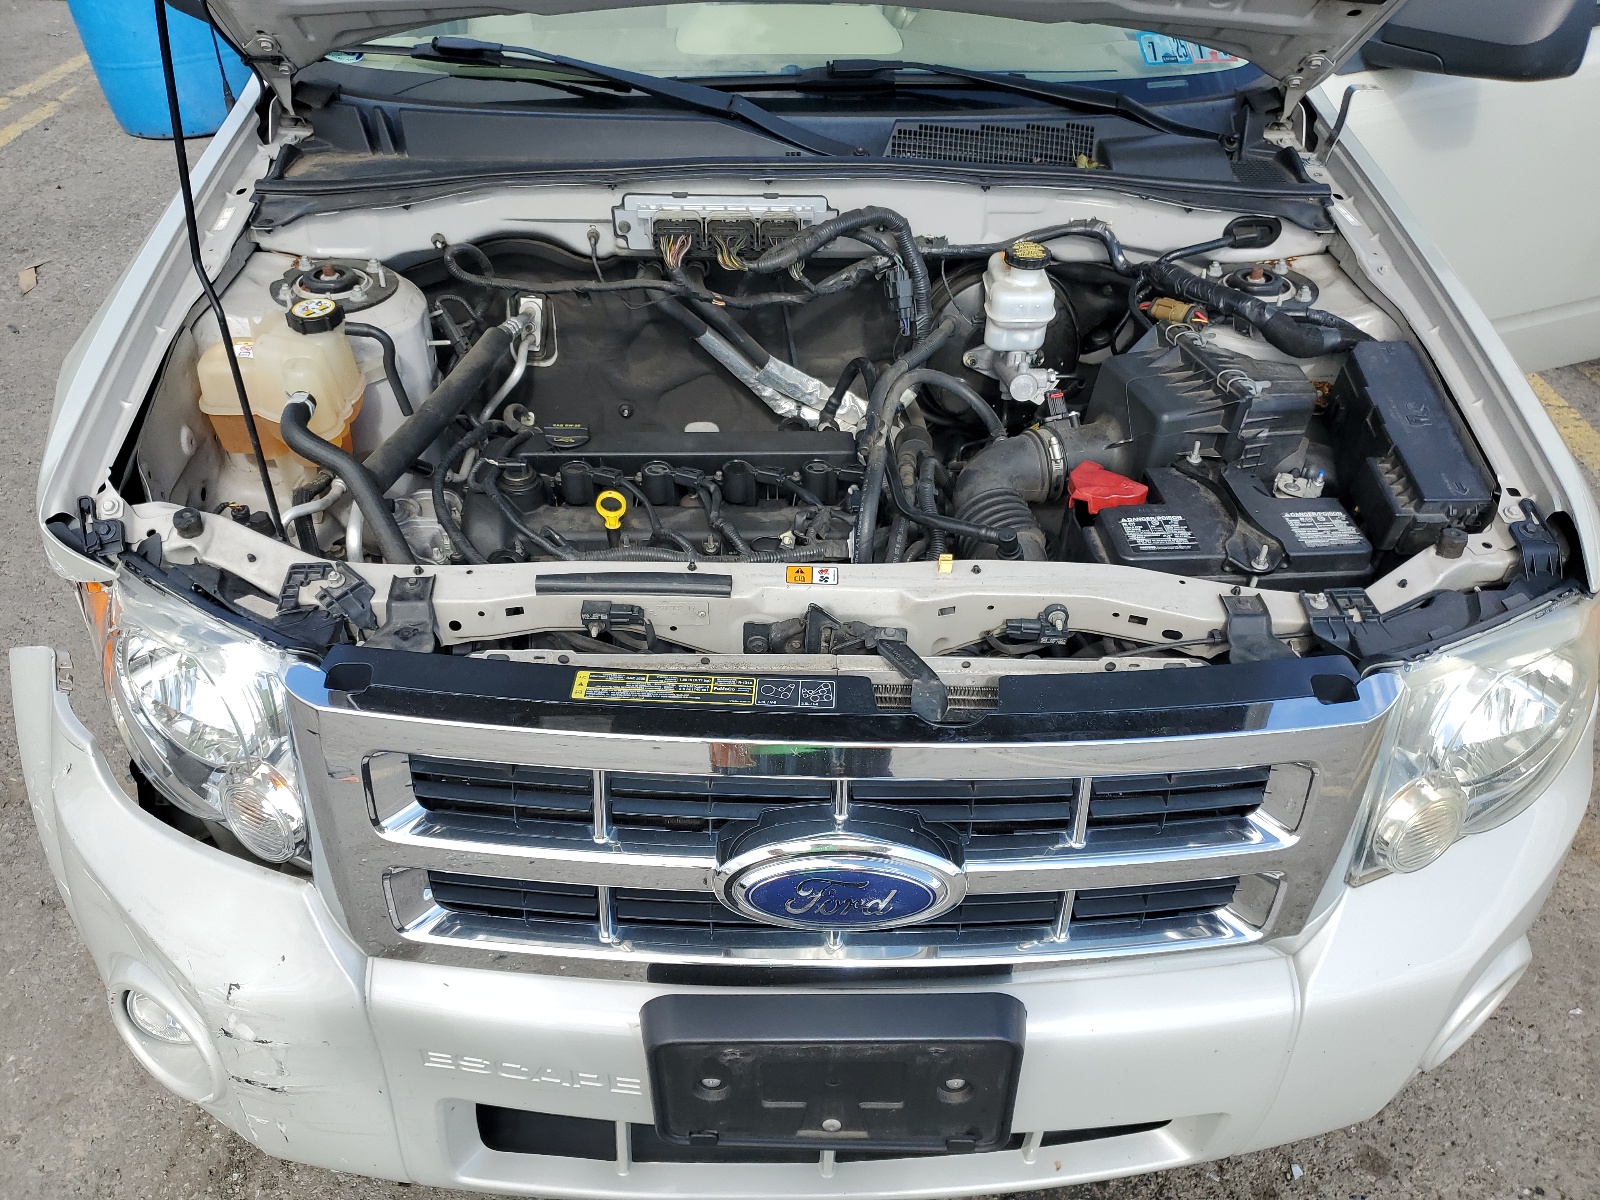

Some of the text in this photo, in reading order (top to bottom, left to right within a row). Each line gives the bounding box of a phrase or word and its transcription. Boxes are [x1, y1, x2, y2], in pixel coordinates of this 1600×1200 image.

[1147, 41, 1158, 62] 7
[784, 877, 898, 916] Ford
[419, 1049, 643, 1096] ESCAPE
